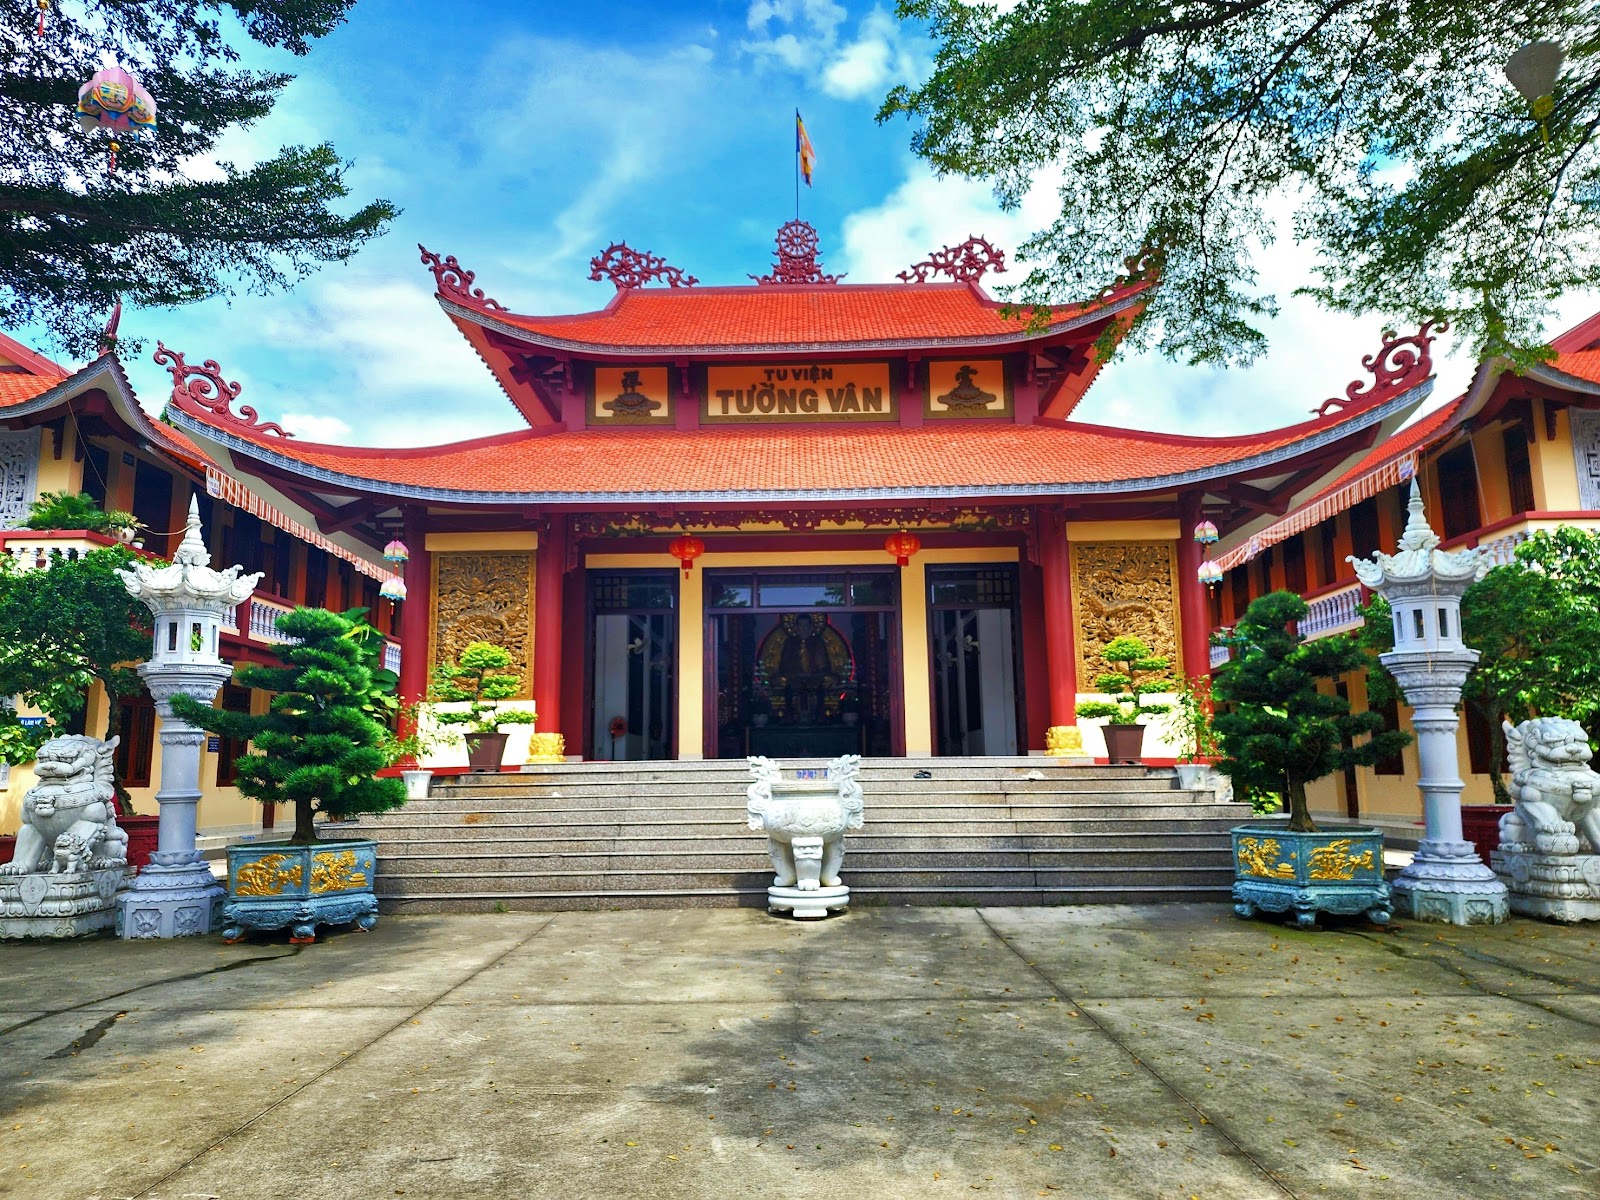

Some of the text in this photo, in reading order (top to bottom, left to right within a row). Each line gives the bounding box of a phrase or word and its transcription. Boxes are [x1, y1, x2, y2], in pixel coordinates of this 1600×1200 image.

[764, 365, 833, 384] TU VIỆN
[716, 382, 882, 414] TƯỜNG VÂN
